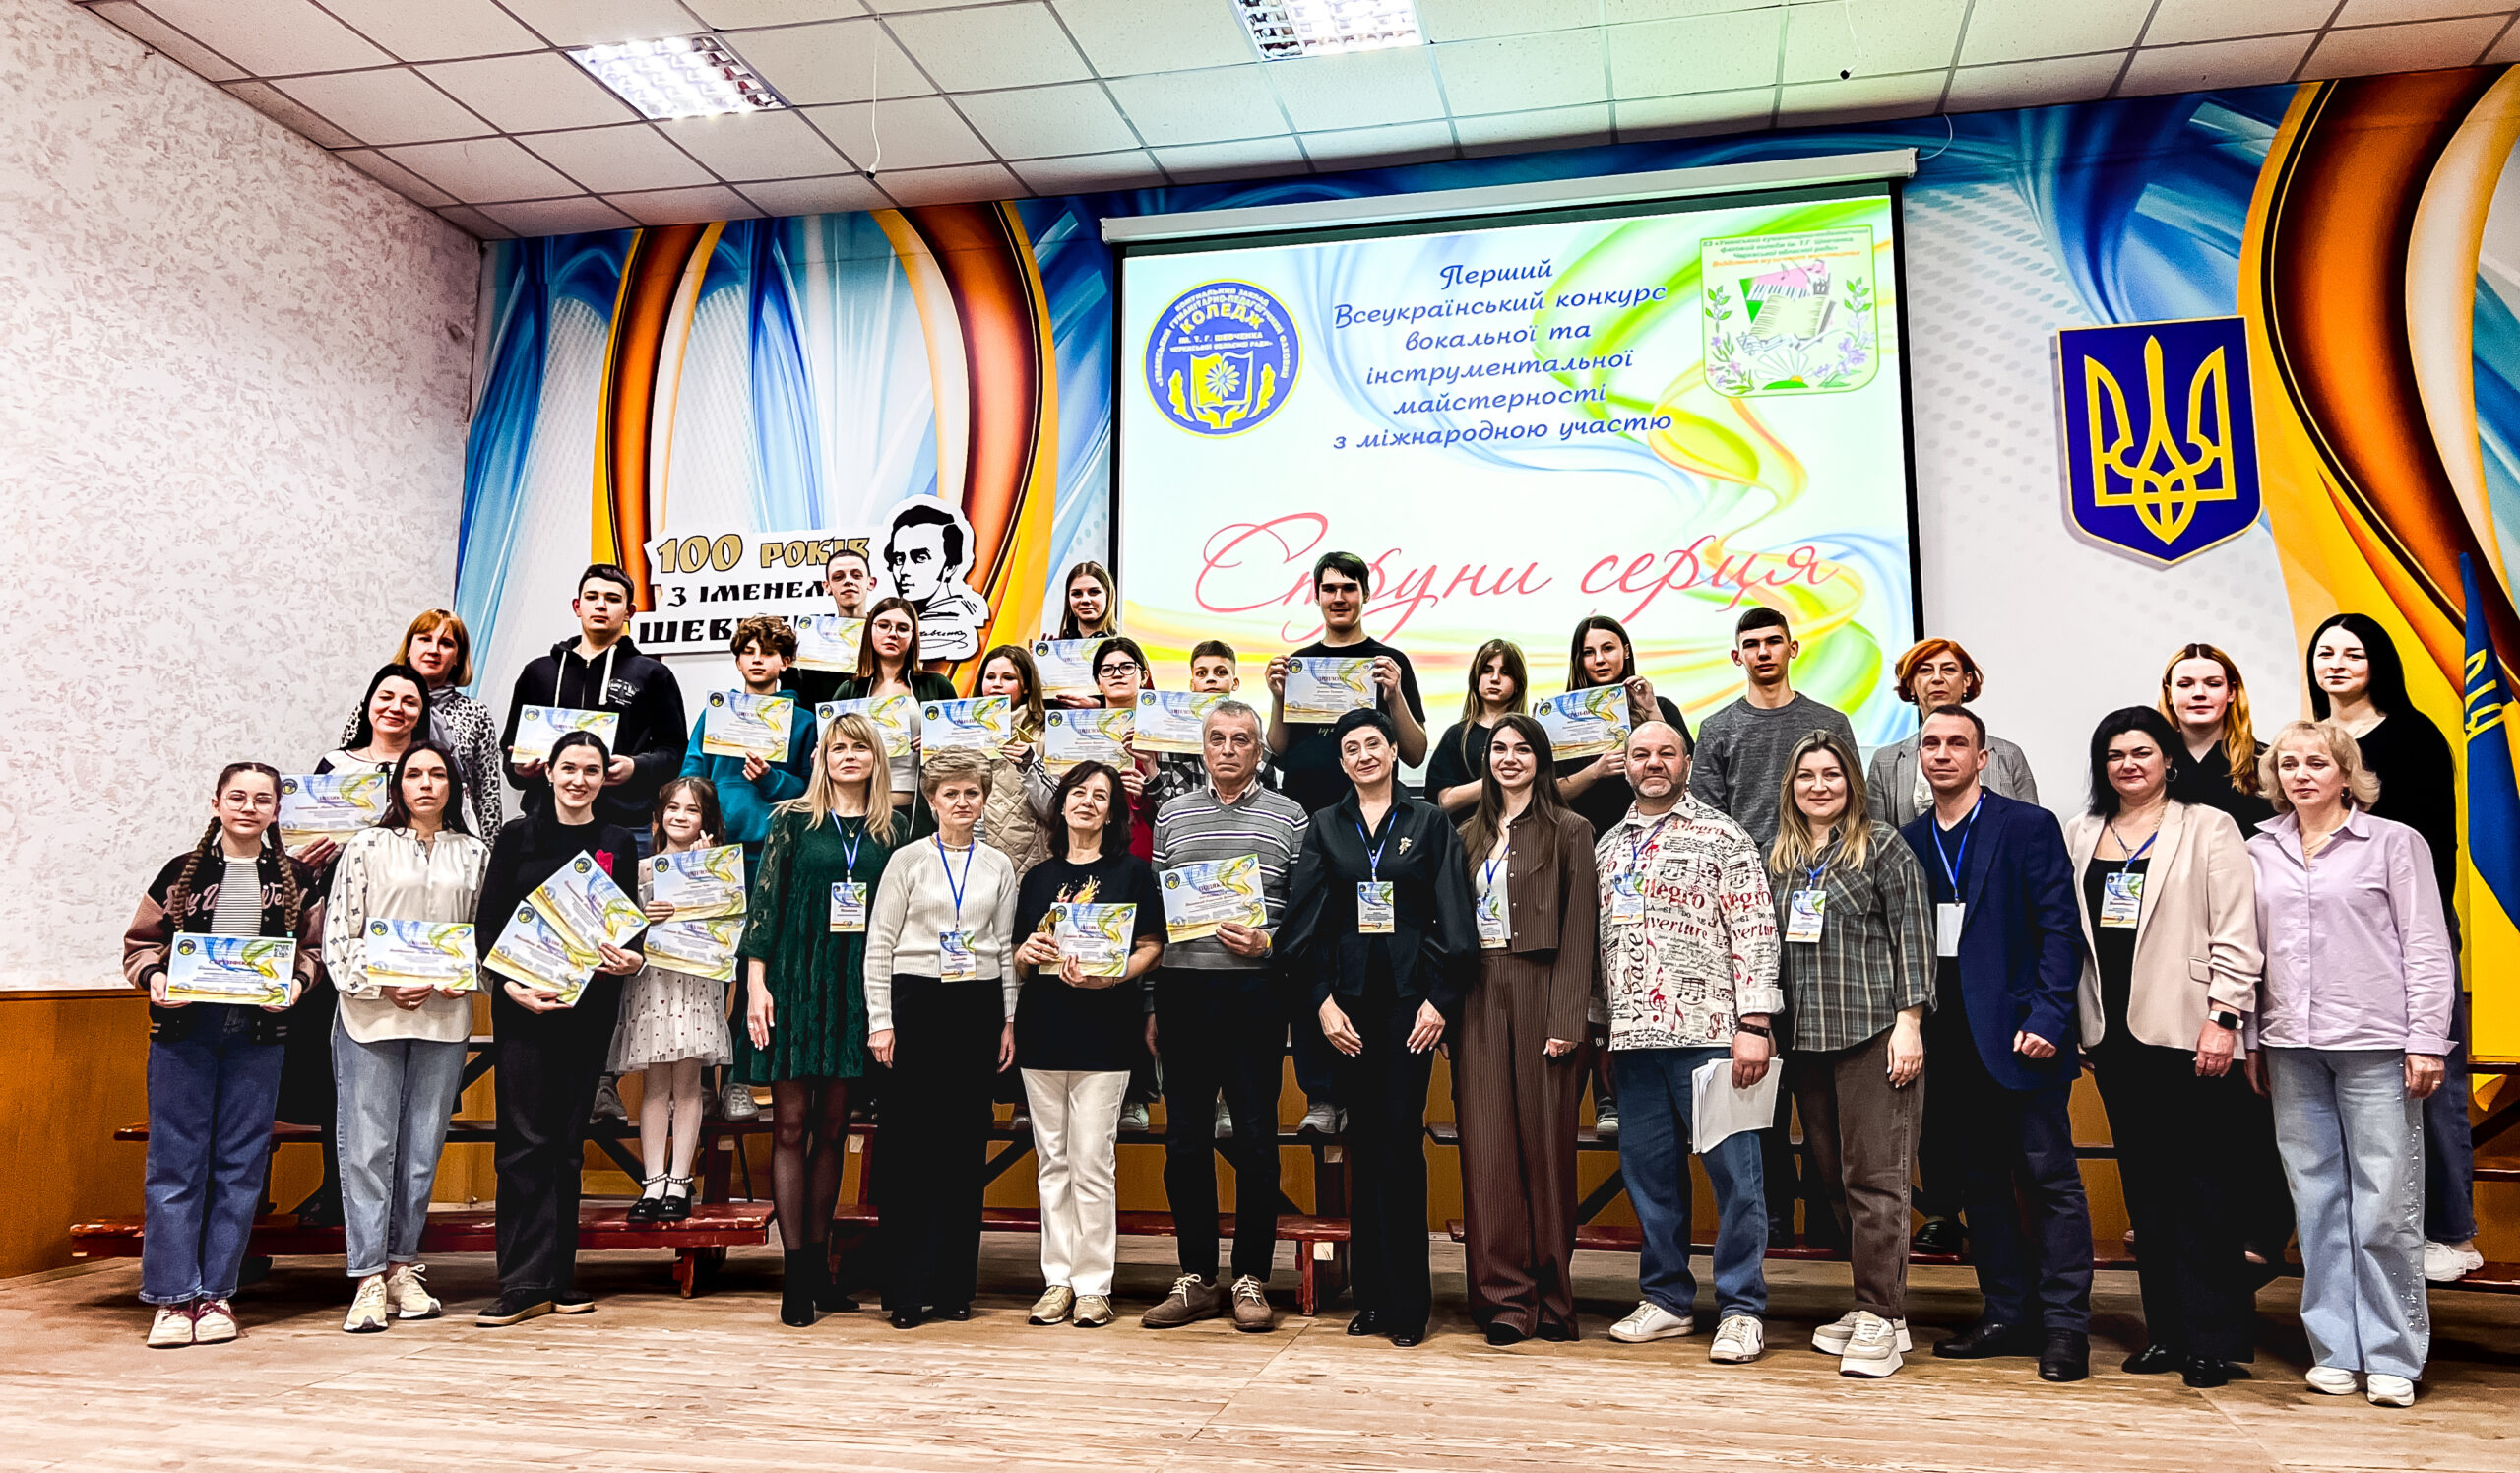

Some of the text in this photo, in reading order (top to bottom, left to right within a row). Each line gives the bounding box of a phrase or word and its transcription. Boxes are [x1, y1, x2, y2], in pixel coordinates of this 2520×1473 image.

[1439, 258, 1553, 289] Перший
[1179, 302, 1265, 335] КОЛЕДЖ
[1334, 286, 1667, 328] Всеукраїнський конкурс
[1406, 323, 1592, 351] вокальної та
[1366, 350, 1634, 386] інструментальної
[1394, 384, 1606, 415] майстерності
[1333, 416, 1671, 450] з міжнародною участю
[657, 534, 743, 574] 100
[1580, 534, 1839, 624] серця
[667, 586, 687, 608] З
[1644, 878, 1705, 909] llegro
[1628, 932, 1644, 1022] vivace
